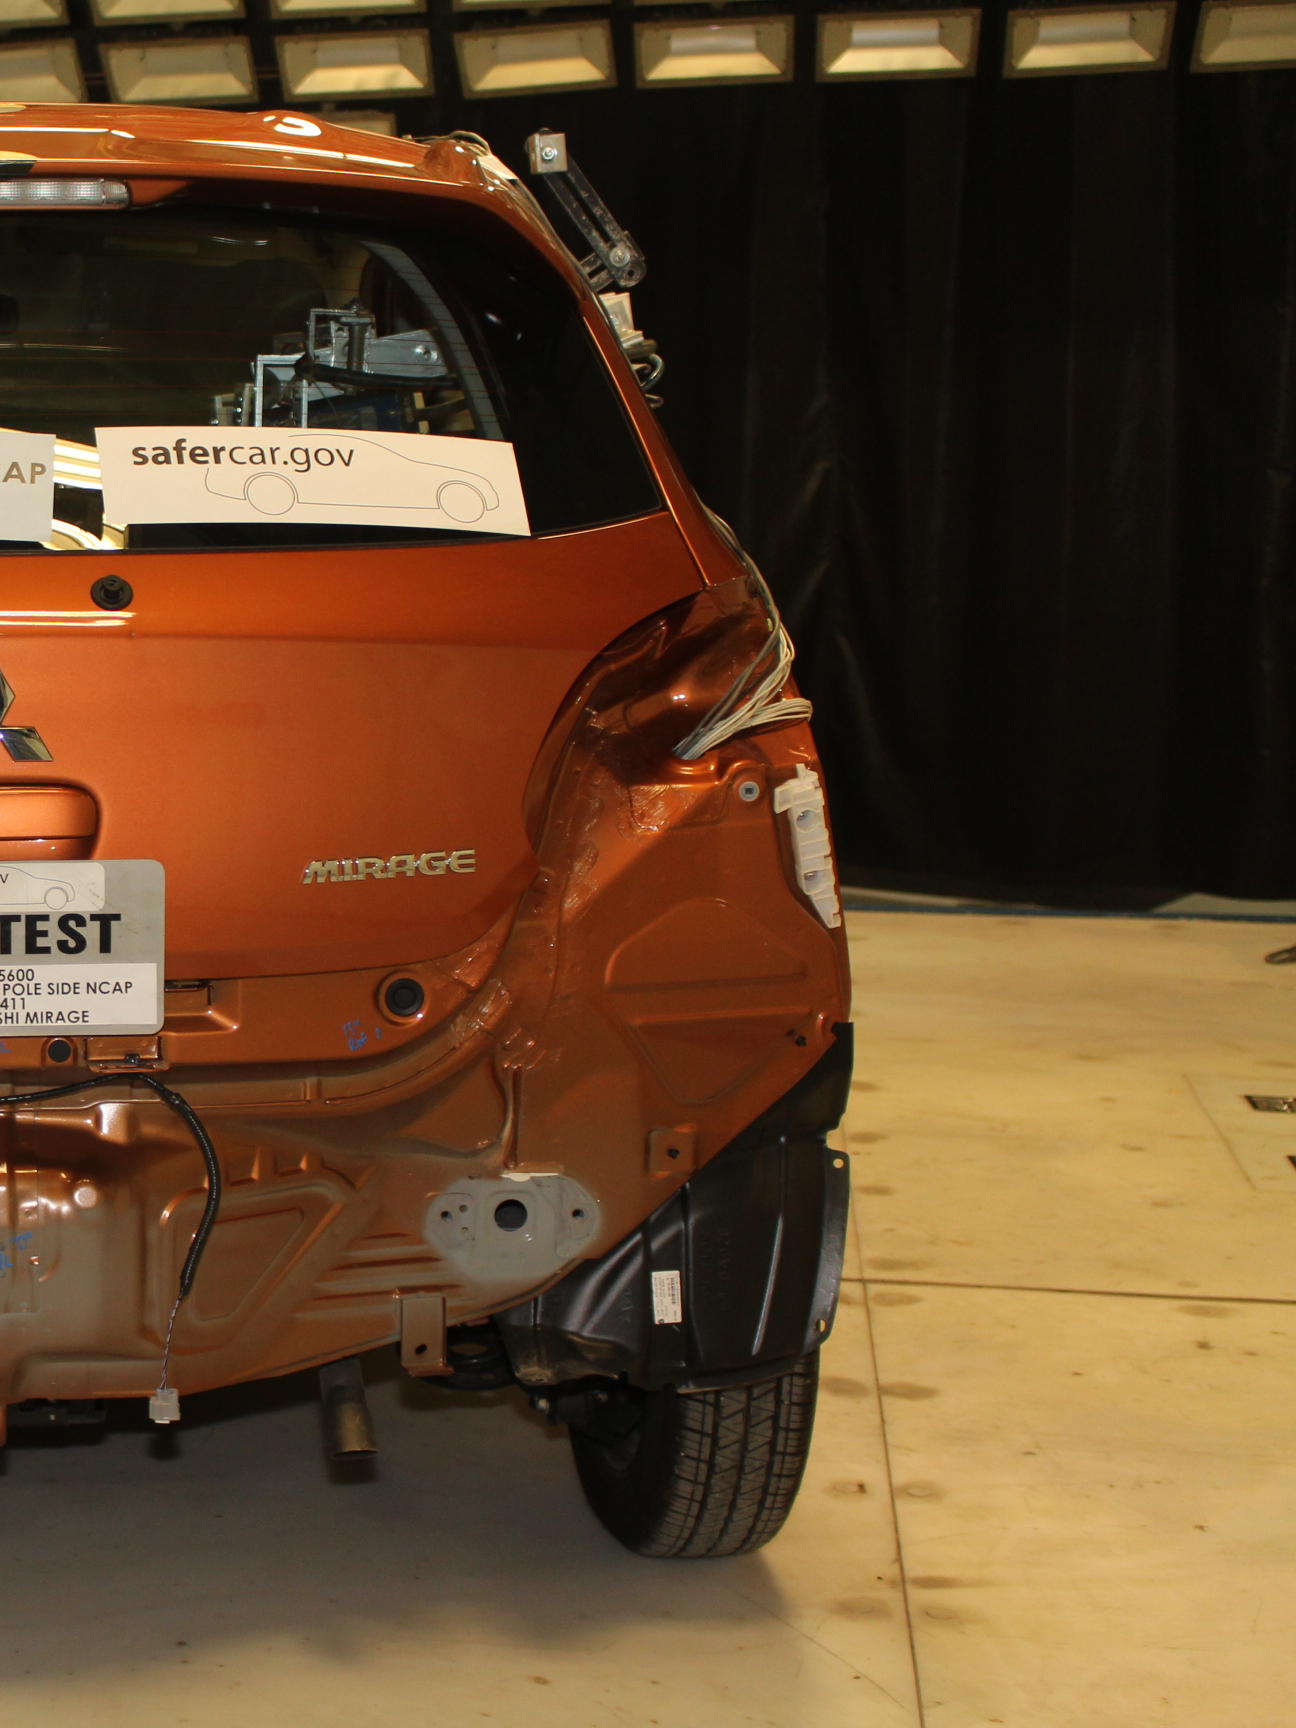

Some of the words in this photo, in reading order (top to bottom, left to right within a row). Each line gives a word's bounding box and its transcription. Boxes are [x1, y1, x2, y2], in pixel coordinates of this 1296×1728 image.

[131, 438, 355, 473] safercar.gov
[302, 848, 476, 885] MIRAGE
[2, 982, 44, 997] POLE
[47, 981, 82, 996] SIDE
[85, 980, 134, 995] NCAP
[24, 1009, 91, 1025] MIRAGE
